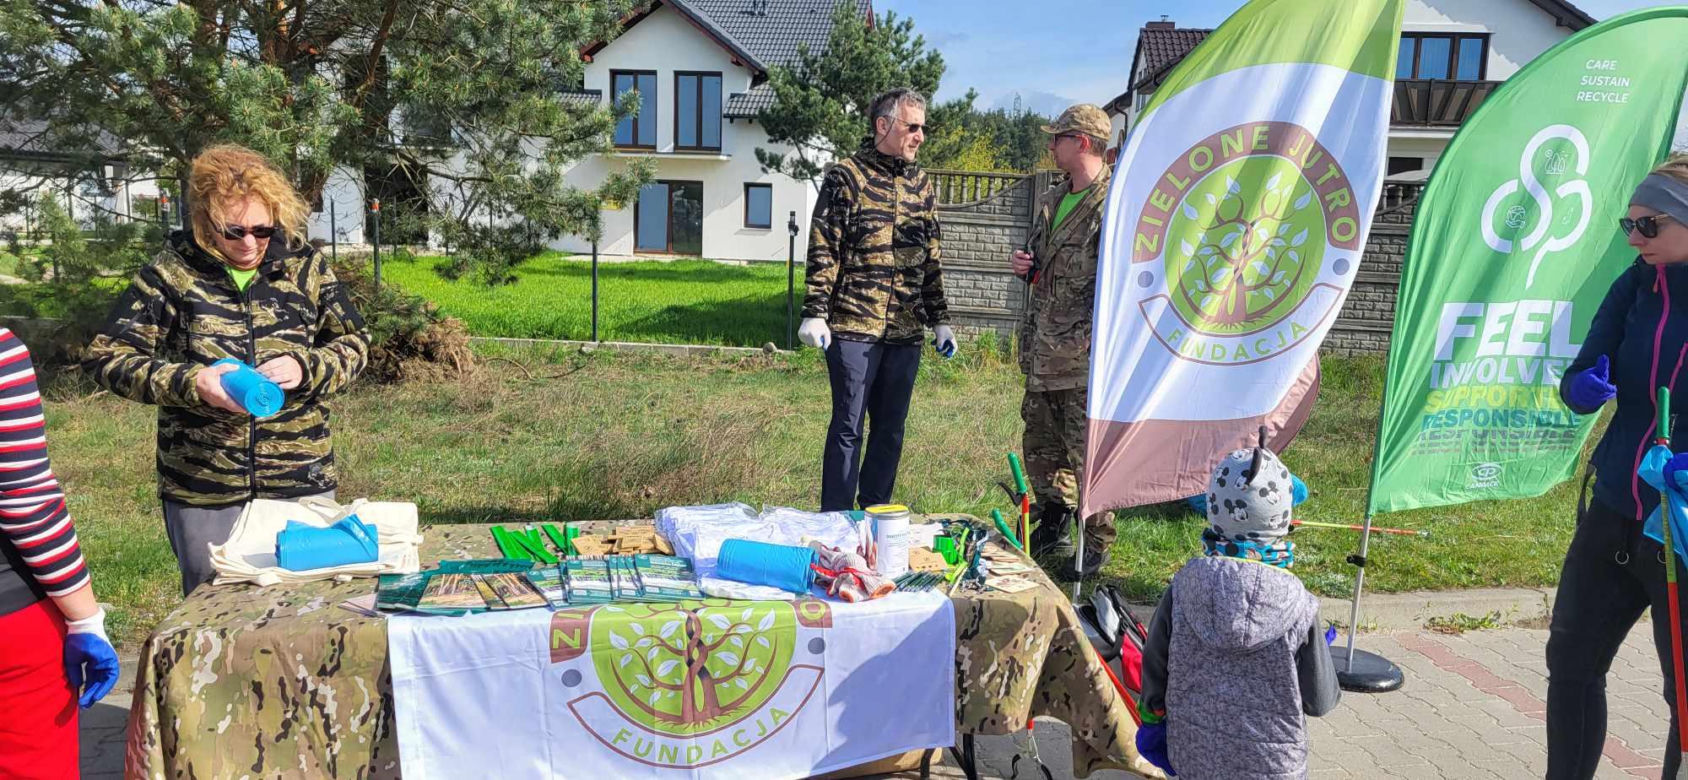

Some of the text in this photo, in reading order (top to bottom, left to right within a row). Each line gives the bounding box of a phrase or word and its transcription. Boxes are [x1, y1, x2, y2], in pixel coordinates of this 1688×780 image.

[1585, 59, 1618, 71] CARE
[1576, 91, 1629, 104] RECYCLE
[1580, 75, 1630, 88] SUSTAIN
[1135, 125, 1358, 253] ZIELONE JUTRO
[1433, 299, 1584, 361] FEEL
[1429, 357, 1573, 389] INVOLVE
[611, 706, 791, 765] FUNDACJA
